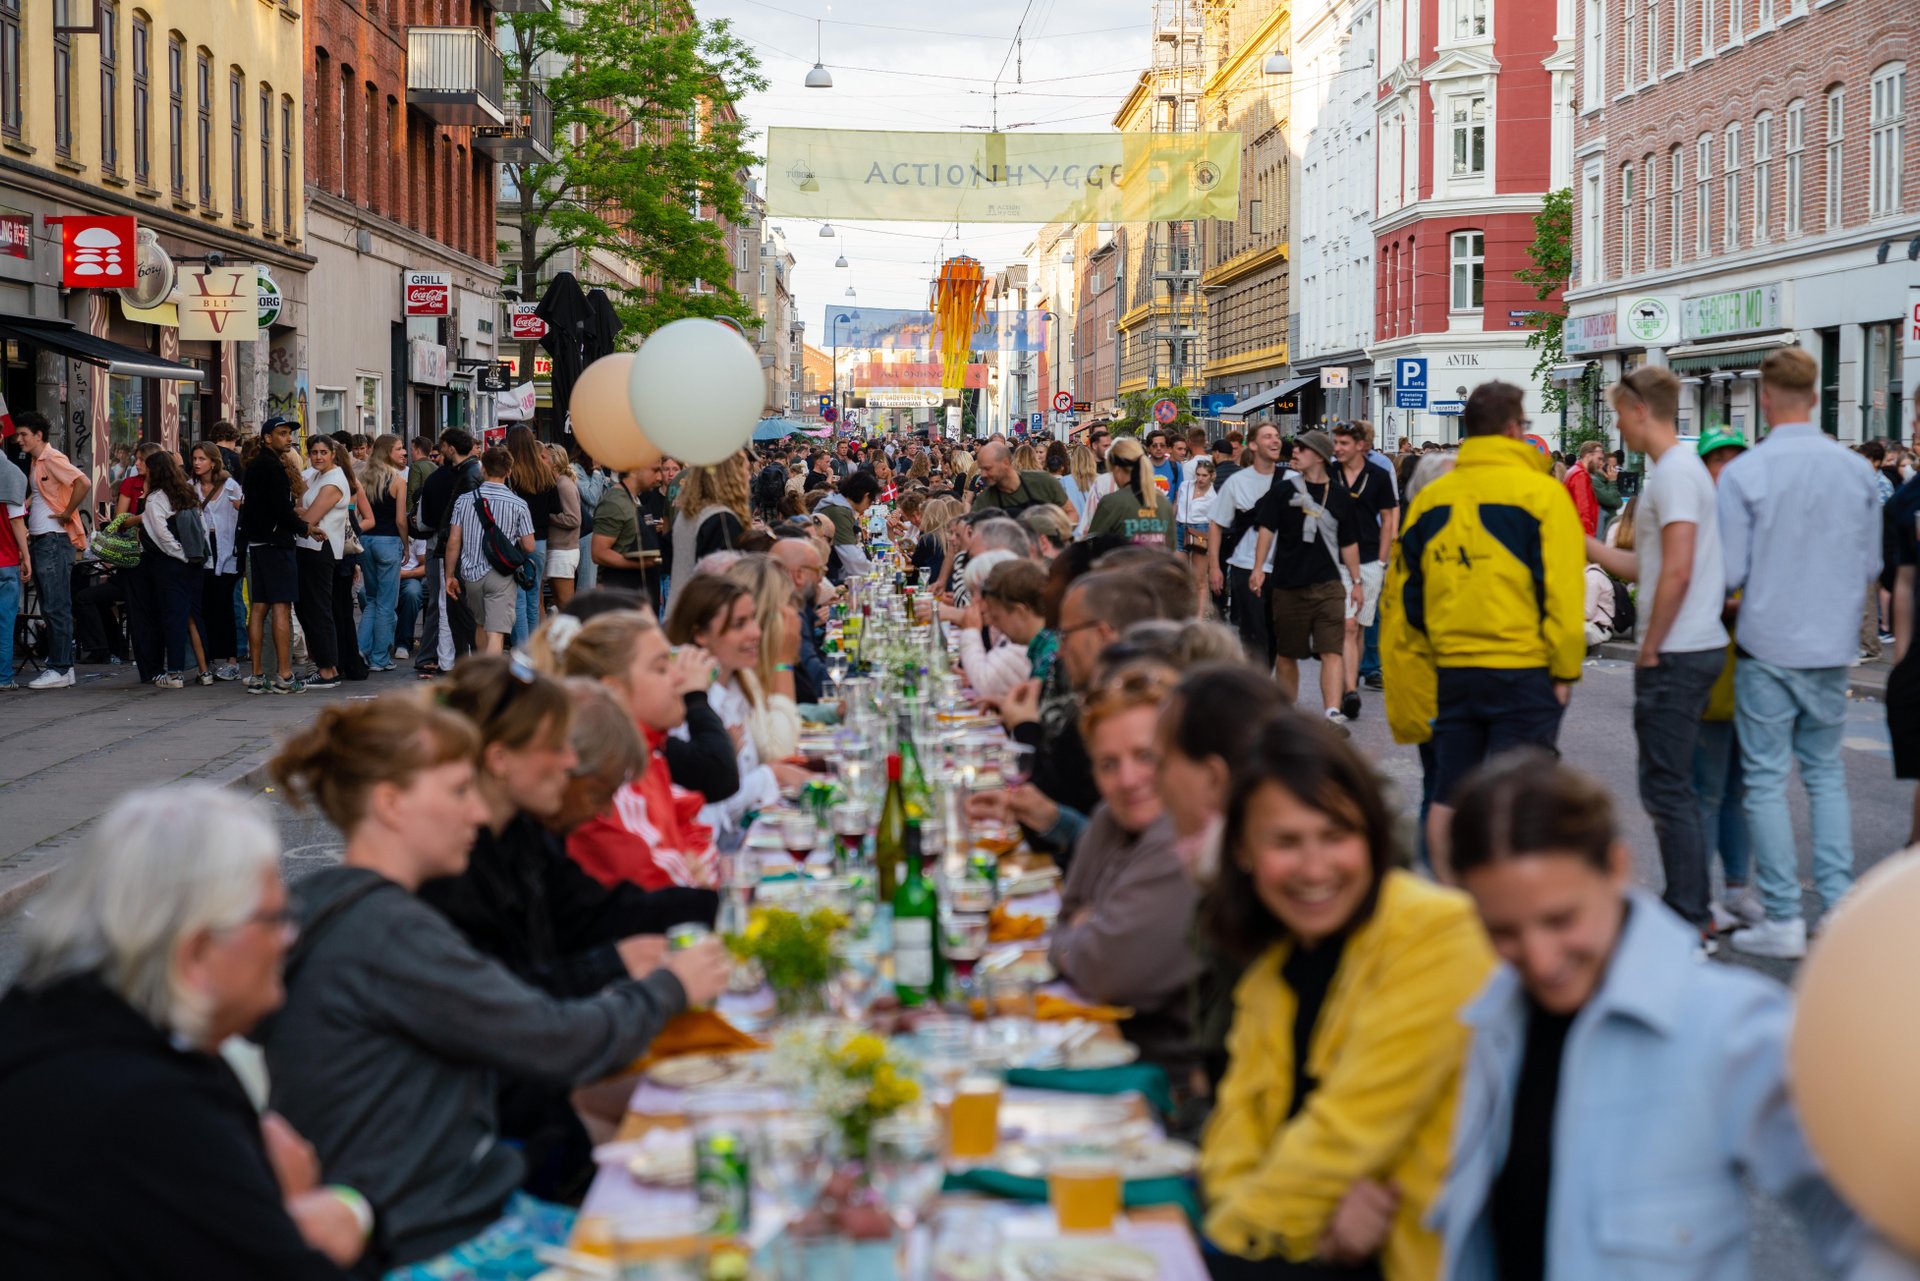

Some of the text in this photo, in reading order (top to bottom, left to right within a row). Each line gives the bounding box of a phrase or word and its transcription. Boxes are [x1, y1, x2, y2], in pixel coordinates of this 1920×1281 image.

[411, 275, 443, 285] GRILL
[1744, 288, 1762, 329] MO
[1445, 354, 1480, 366] ANTIK
[1403, 361, 1421, 386] P
